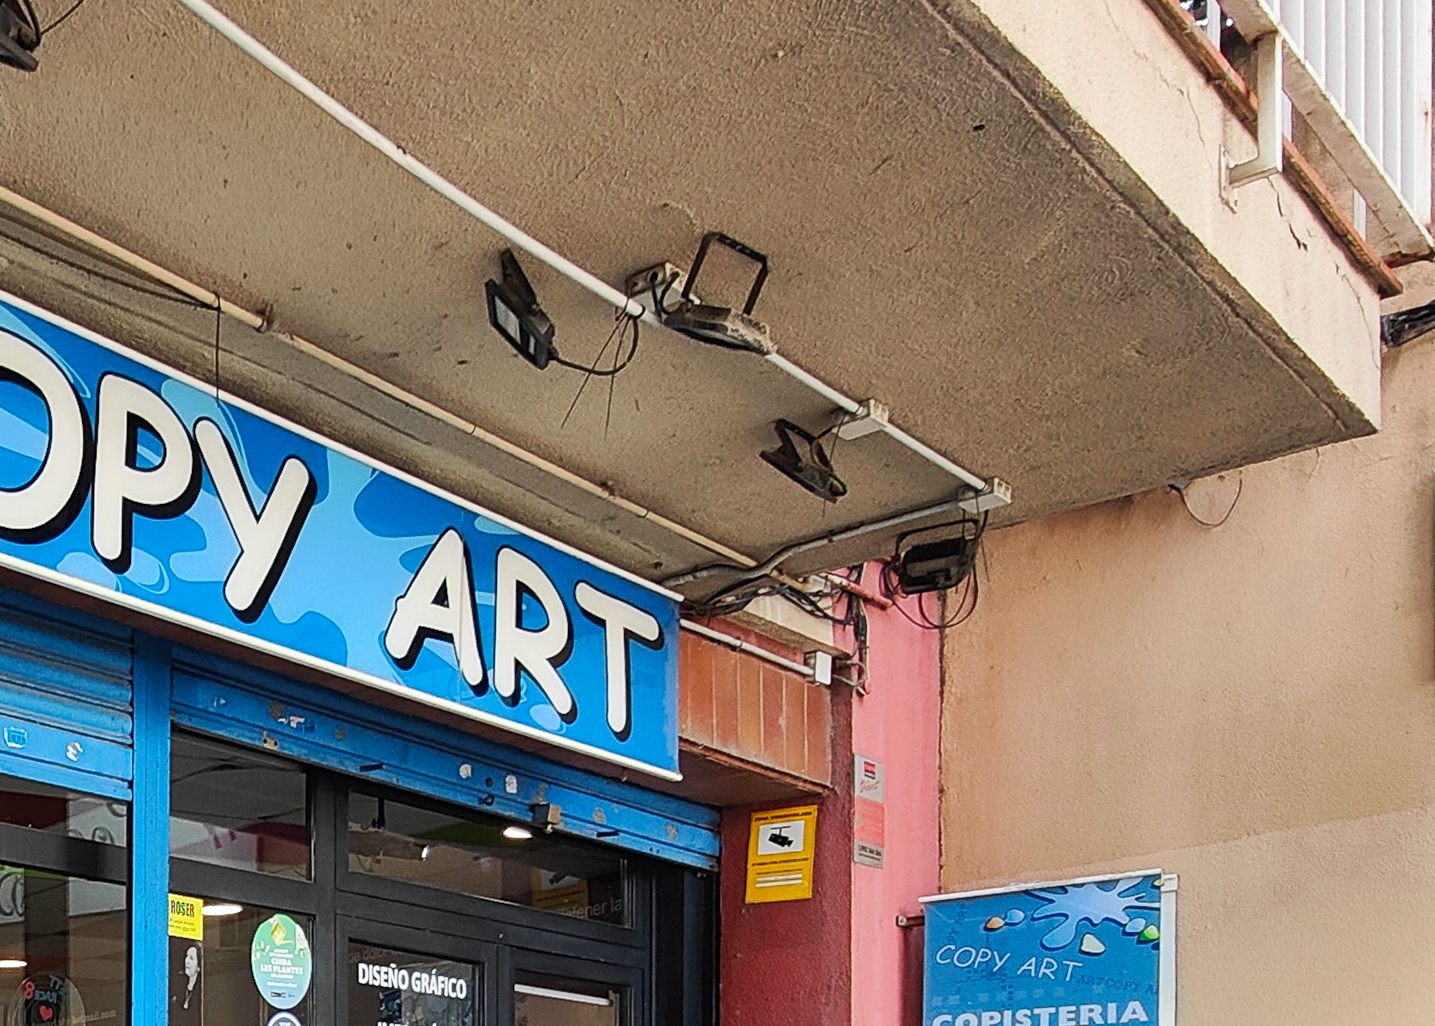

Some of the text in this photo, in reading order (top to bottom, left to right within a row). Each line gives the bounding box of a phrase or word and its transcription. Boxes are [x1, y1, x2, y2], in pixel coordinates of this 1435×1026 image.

[385, 528, 663, 740] ART
[358, 963, 467, 999] DISEÑO GRÁFICO
[936, 945, 1083, 981] COPY ART
